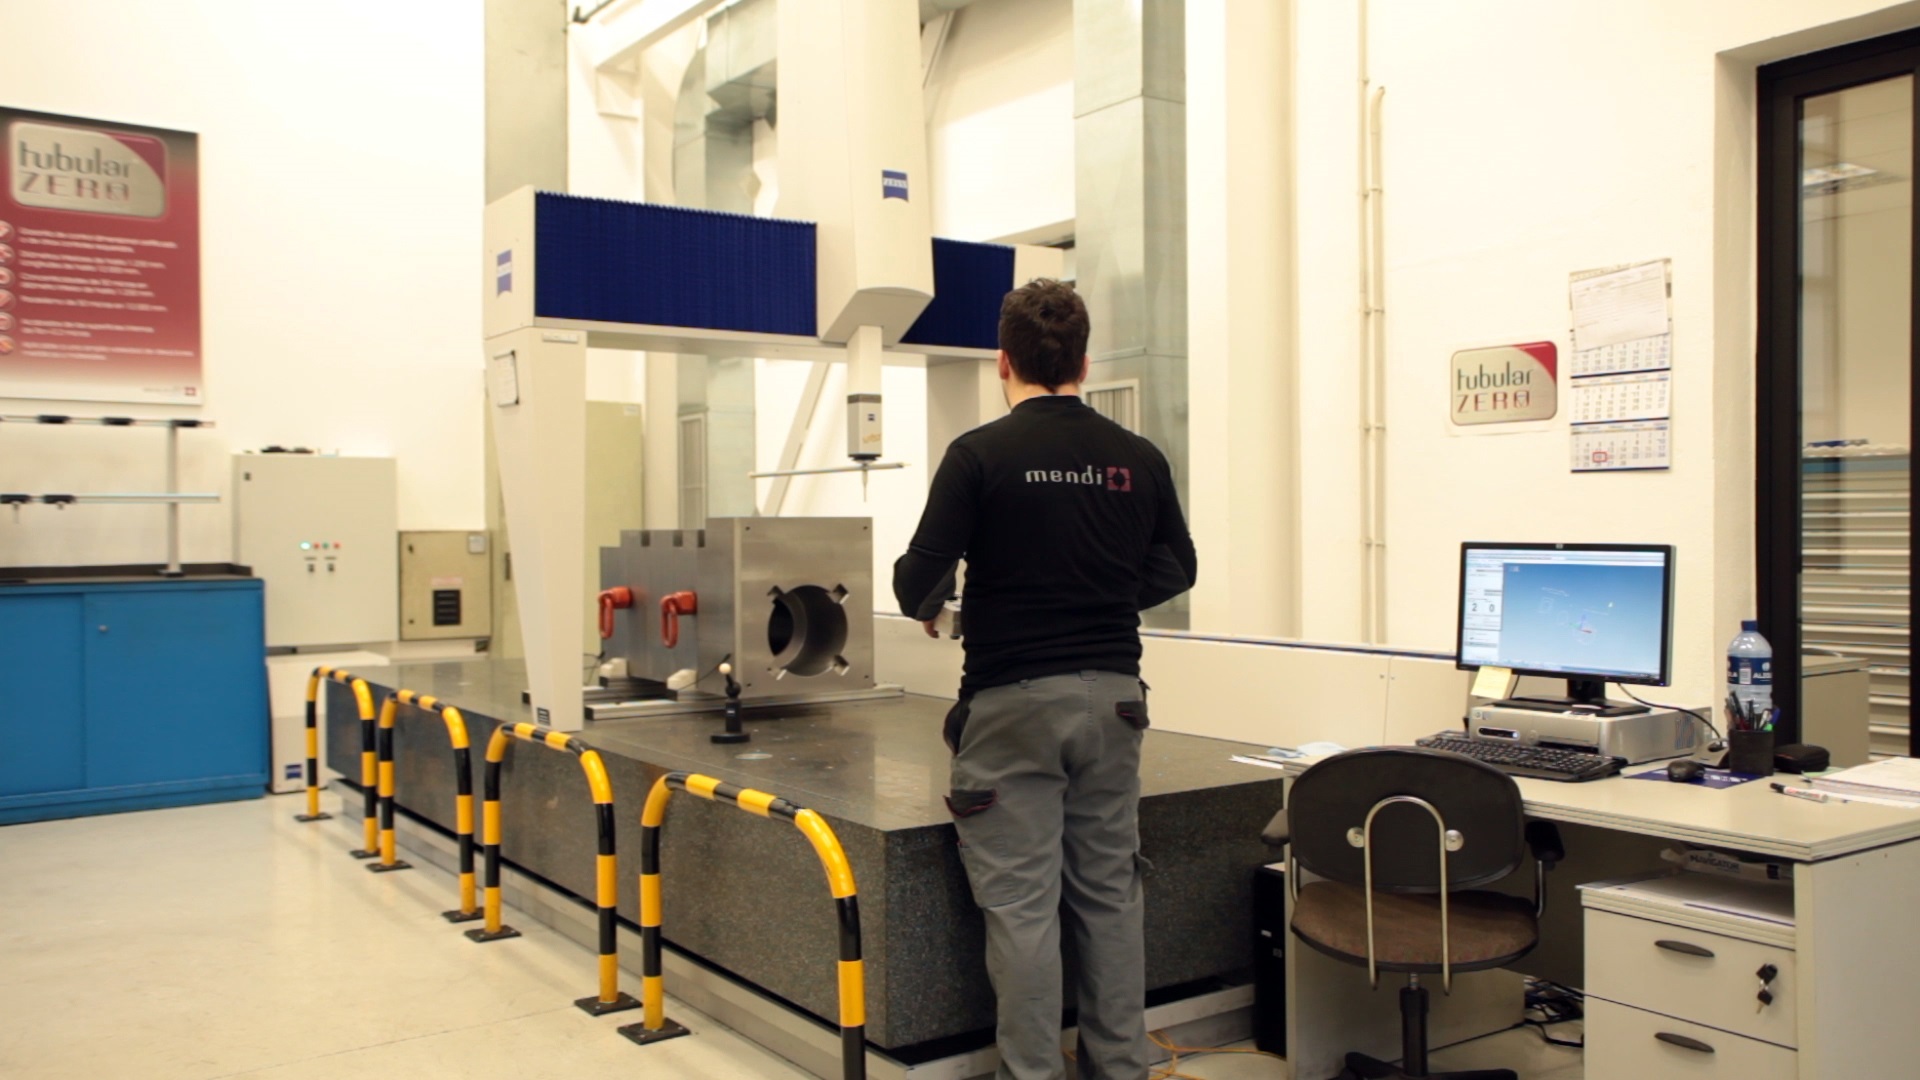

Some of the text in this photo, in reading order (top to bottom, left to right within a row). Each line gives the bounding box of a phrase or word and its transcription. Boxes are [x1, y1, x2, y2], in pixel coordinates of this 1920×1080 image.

[18, 139, 131, 178] tubular
[18, 169, 130, 201] ZERO
[1457, 361, 1534, 391] tubular
[1456, 389, 1530, 413] ZERO
[1025, 465, 1102, 485] mendi
